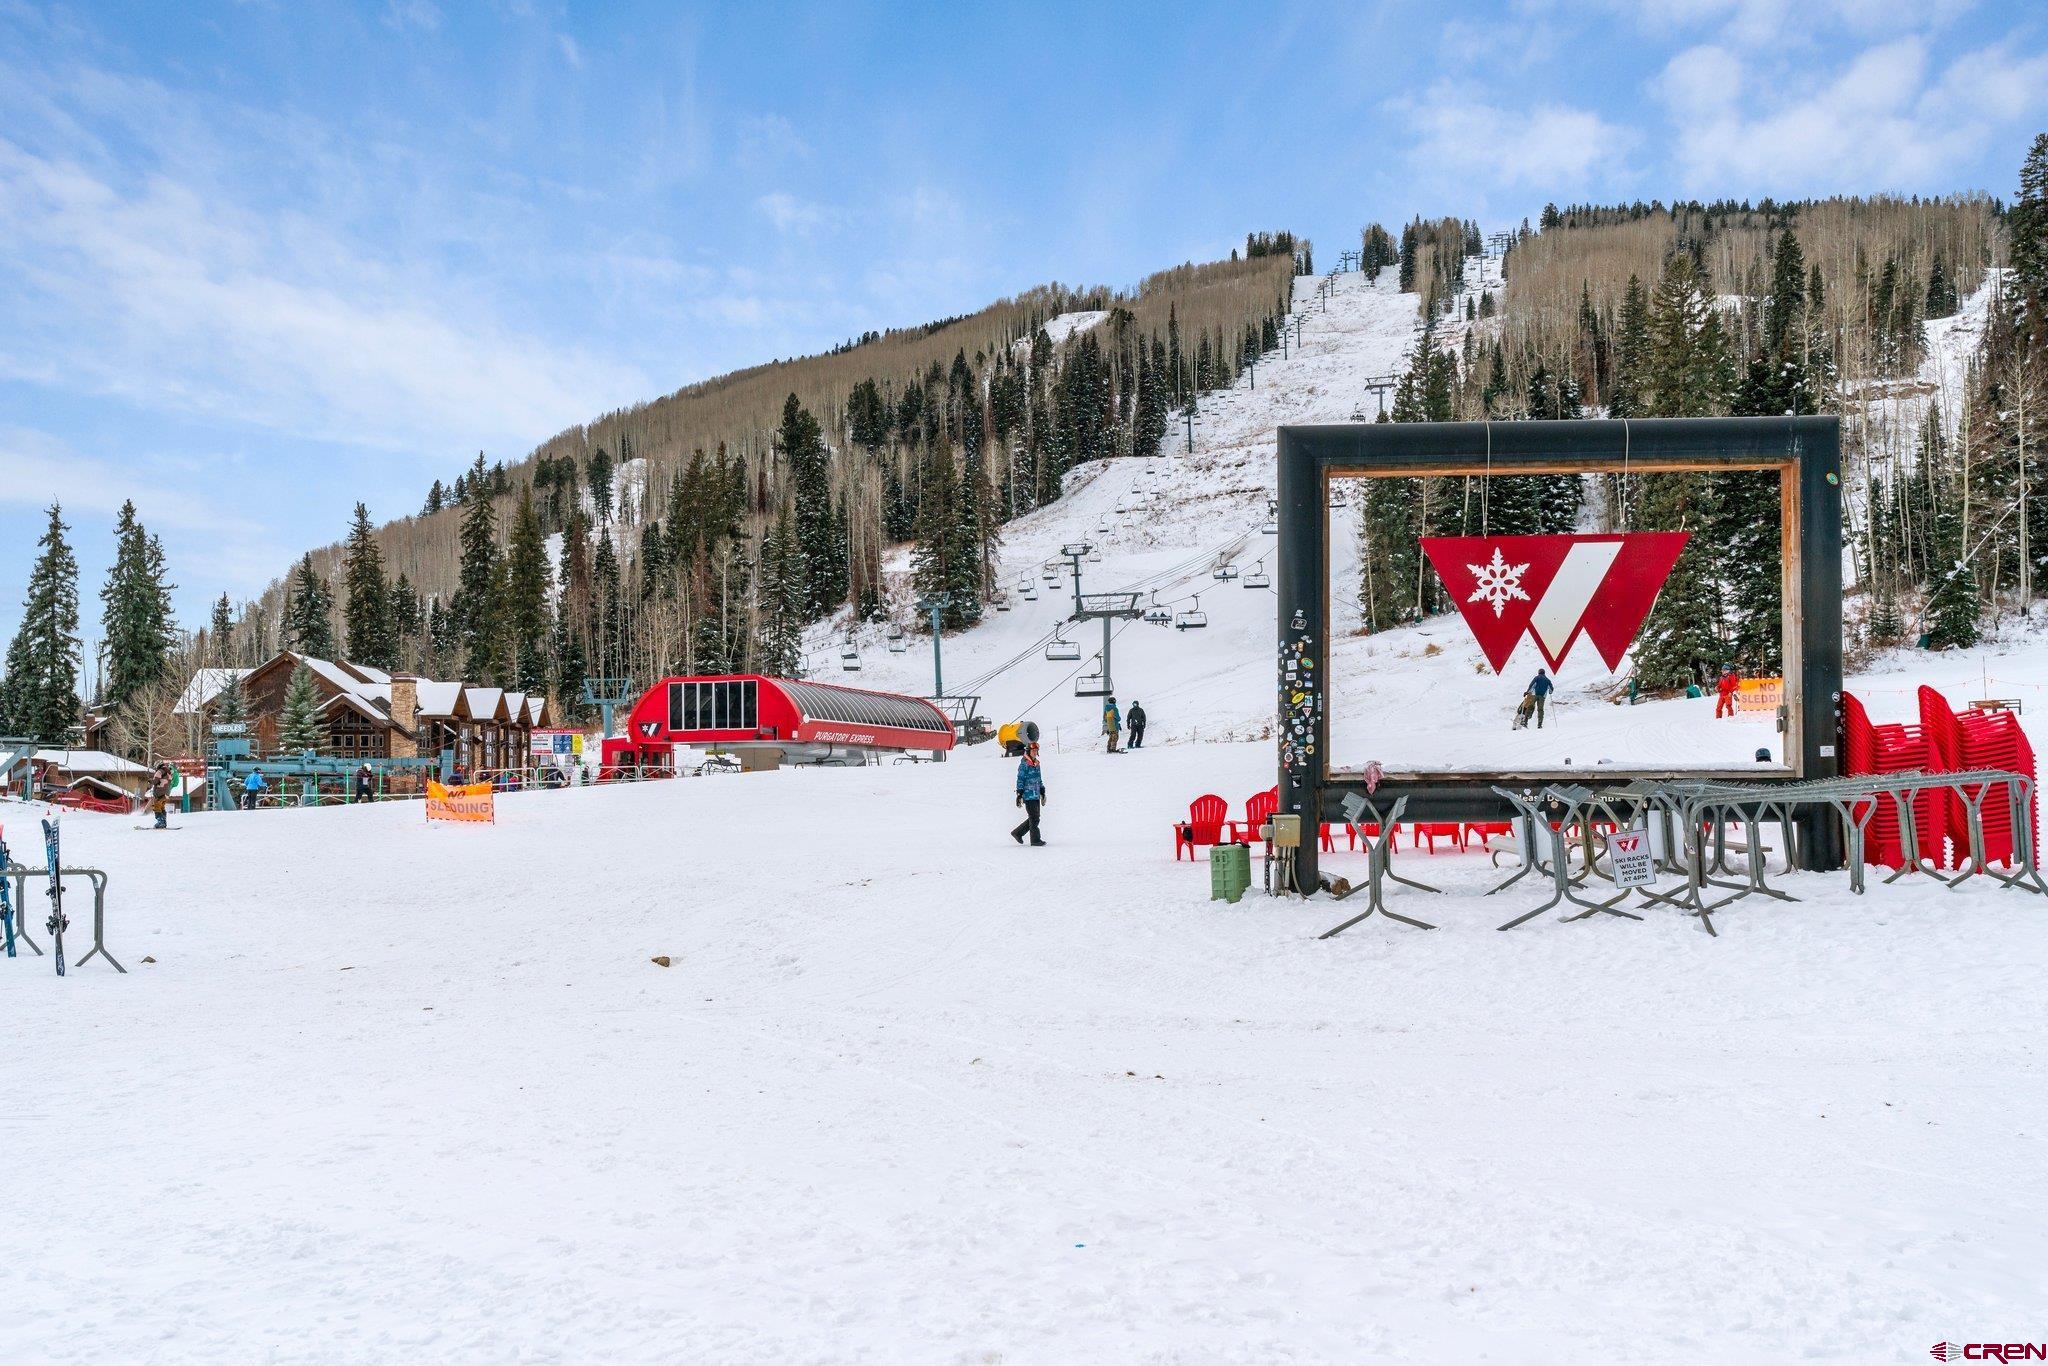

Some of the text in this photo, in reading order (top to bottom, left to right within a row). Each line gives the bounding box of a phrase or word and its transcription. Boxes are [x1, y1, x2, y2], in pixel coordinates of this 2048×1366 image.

[1759, 682, 1776, 692] NO
[1741, 694, 1781, 704] SLEDDI
[813, 731, 875, 744] PURGATORY EXPRESS
[447, 790, 466, 799] NO
[430, 800, 489, 814] SLEDDING
[1614, 854, 1650, 865] SKI RACKS
[1621, 867, 1647, 876] MOVED
